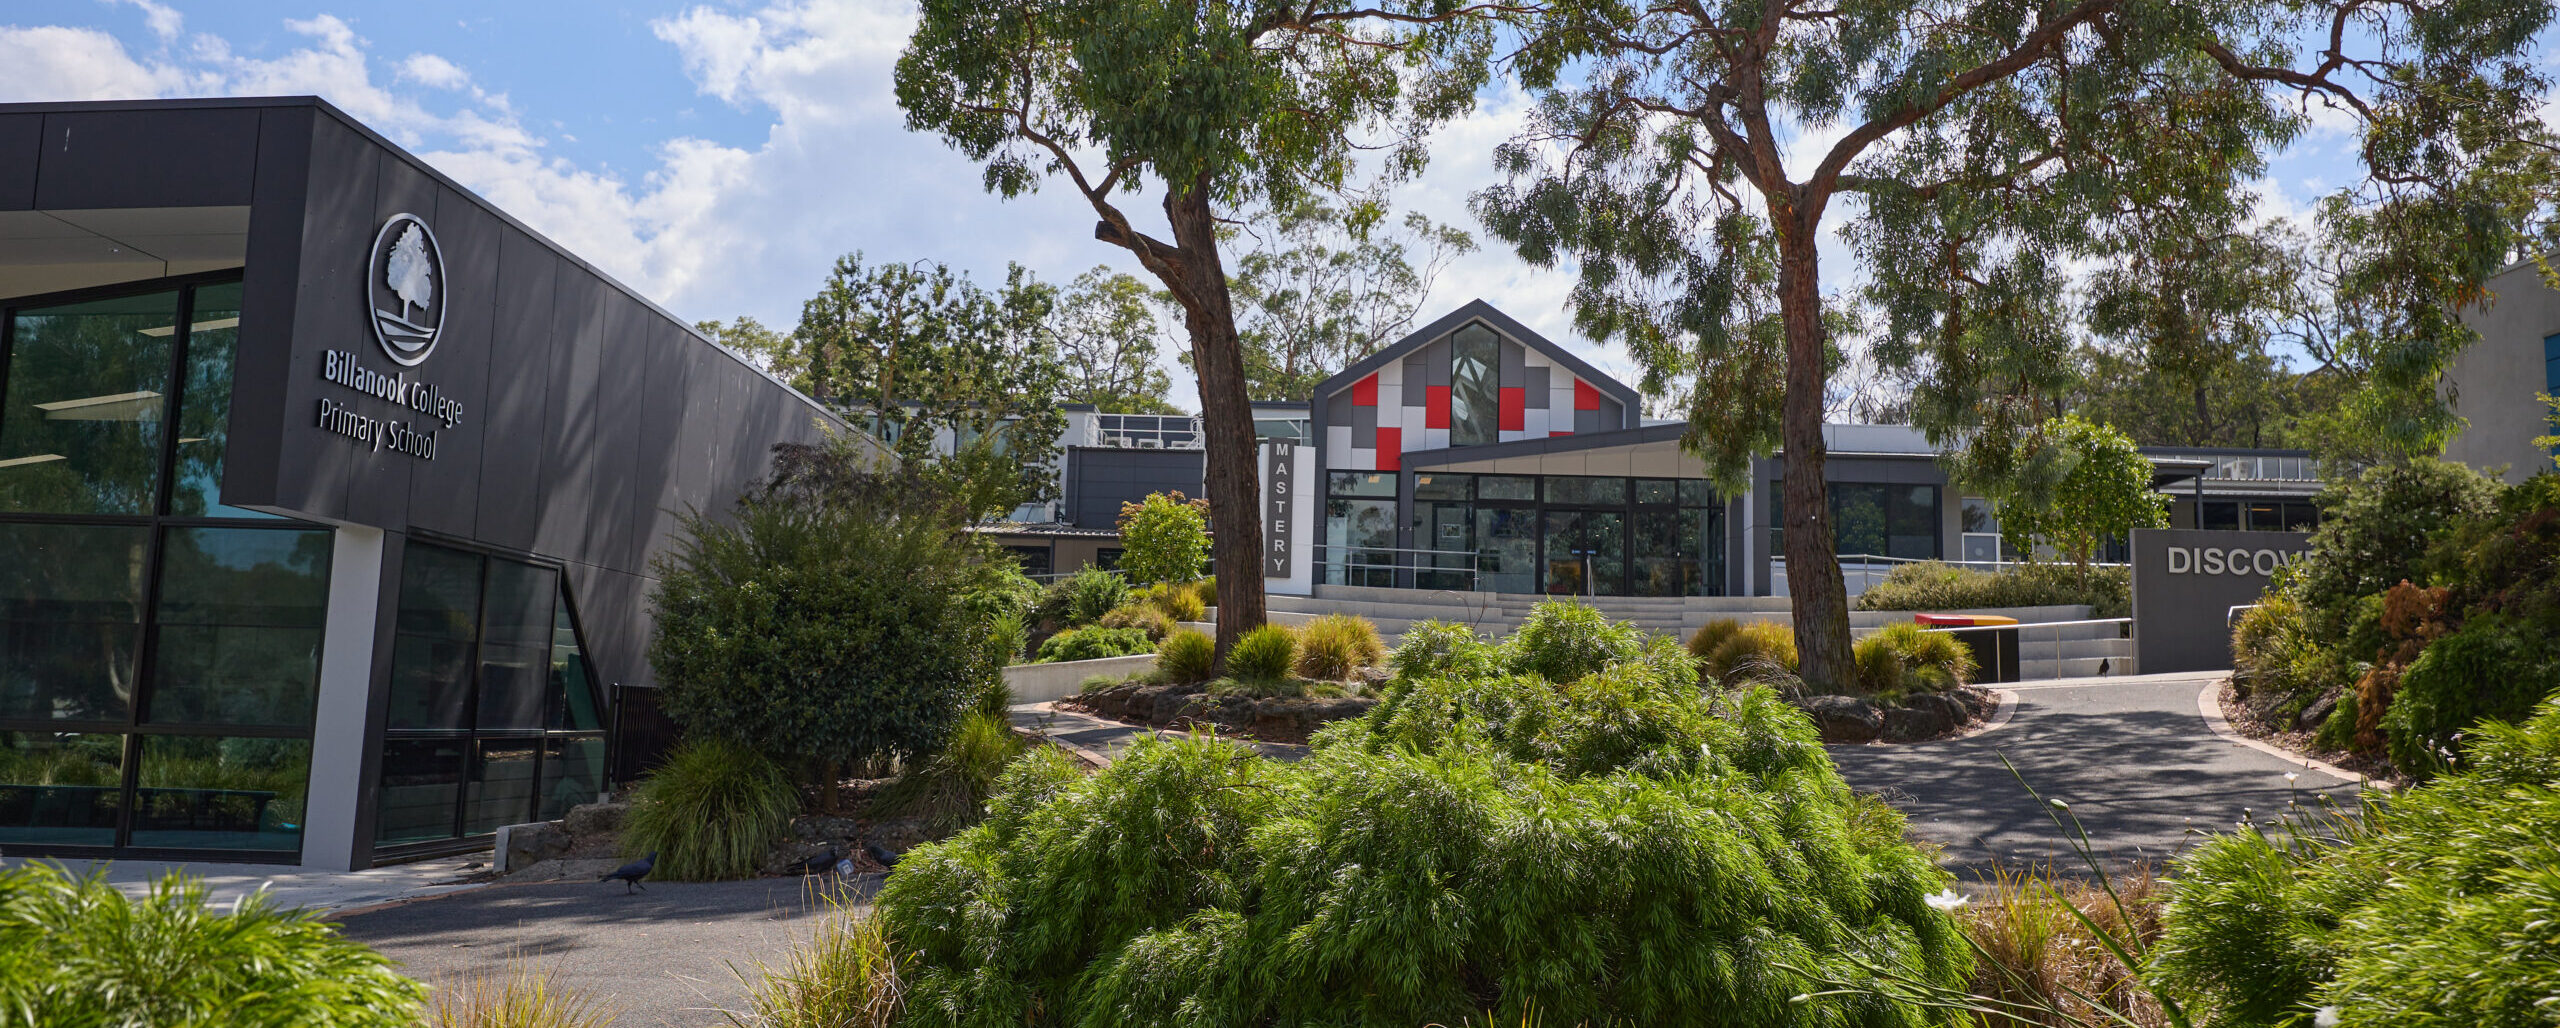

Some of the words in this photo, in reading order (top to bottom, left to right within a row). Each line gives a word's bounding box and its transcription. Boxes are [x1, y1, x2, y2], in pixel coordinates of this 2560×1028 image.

[325, 349, 407, 405] Billanook
[411, 381, 463, 429] College
[319, 398, 384, 452] Primary
[388, 420, 438, 461] School
[1273, 443, 1289, 572] MASTERY
